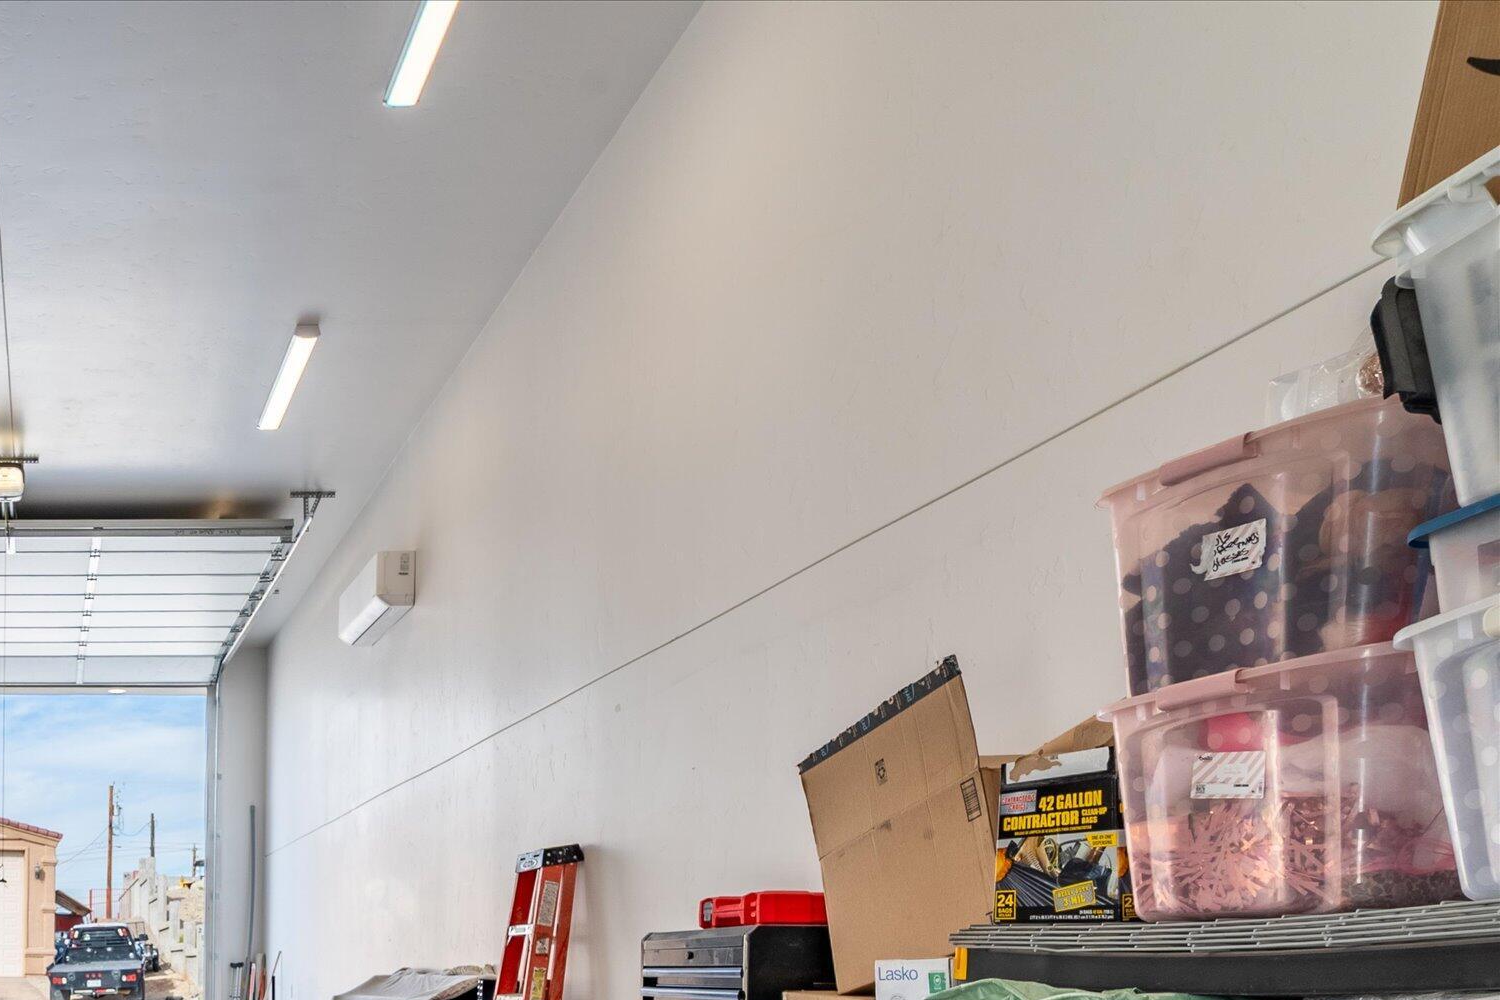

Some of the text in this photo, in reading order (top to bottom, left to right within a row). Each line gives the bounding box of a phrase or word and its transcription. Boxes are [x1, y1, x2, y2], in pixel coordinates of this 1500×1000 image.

[1038, 789, 1103, 812] 42 GALLON
[1003, 810, 1079, 832] CONTRACTOR
[1081, 816, 1098, 825] BAGS
[997, 894, 1014, 907] 24
[878, 966, 919, 981] Lasko
